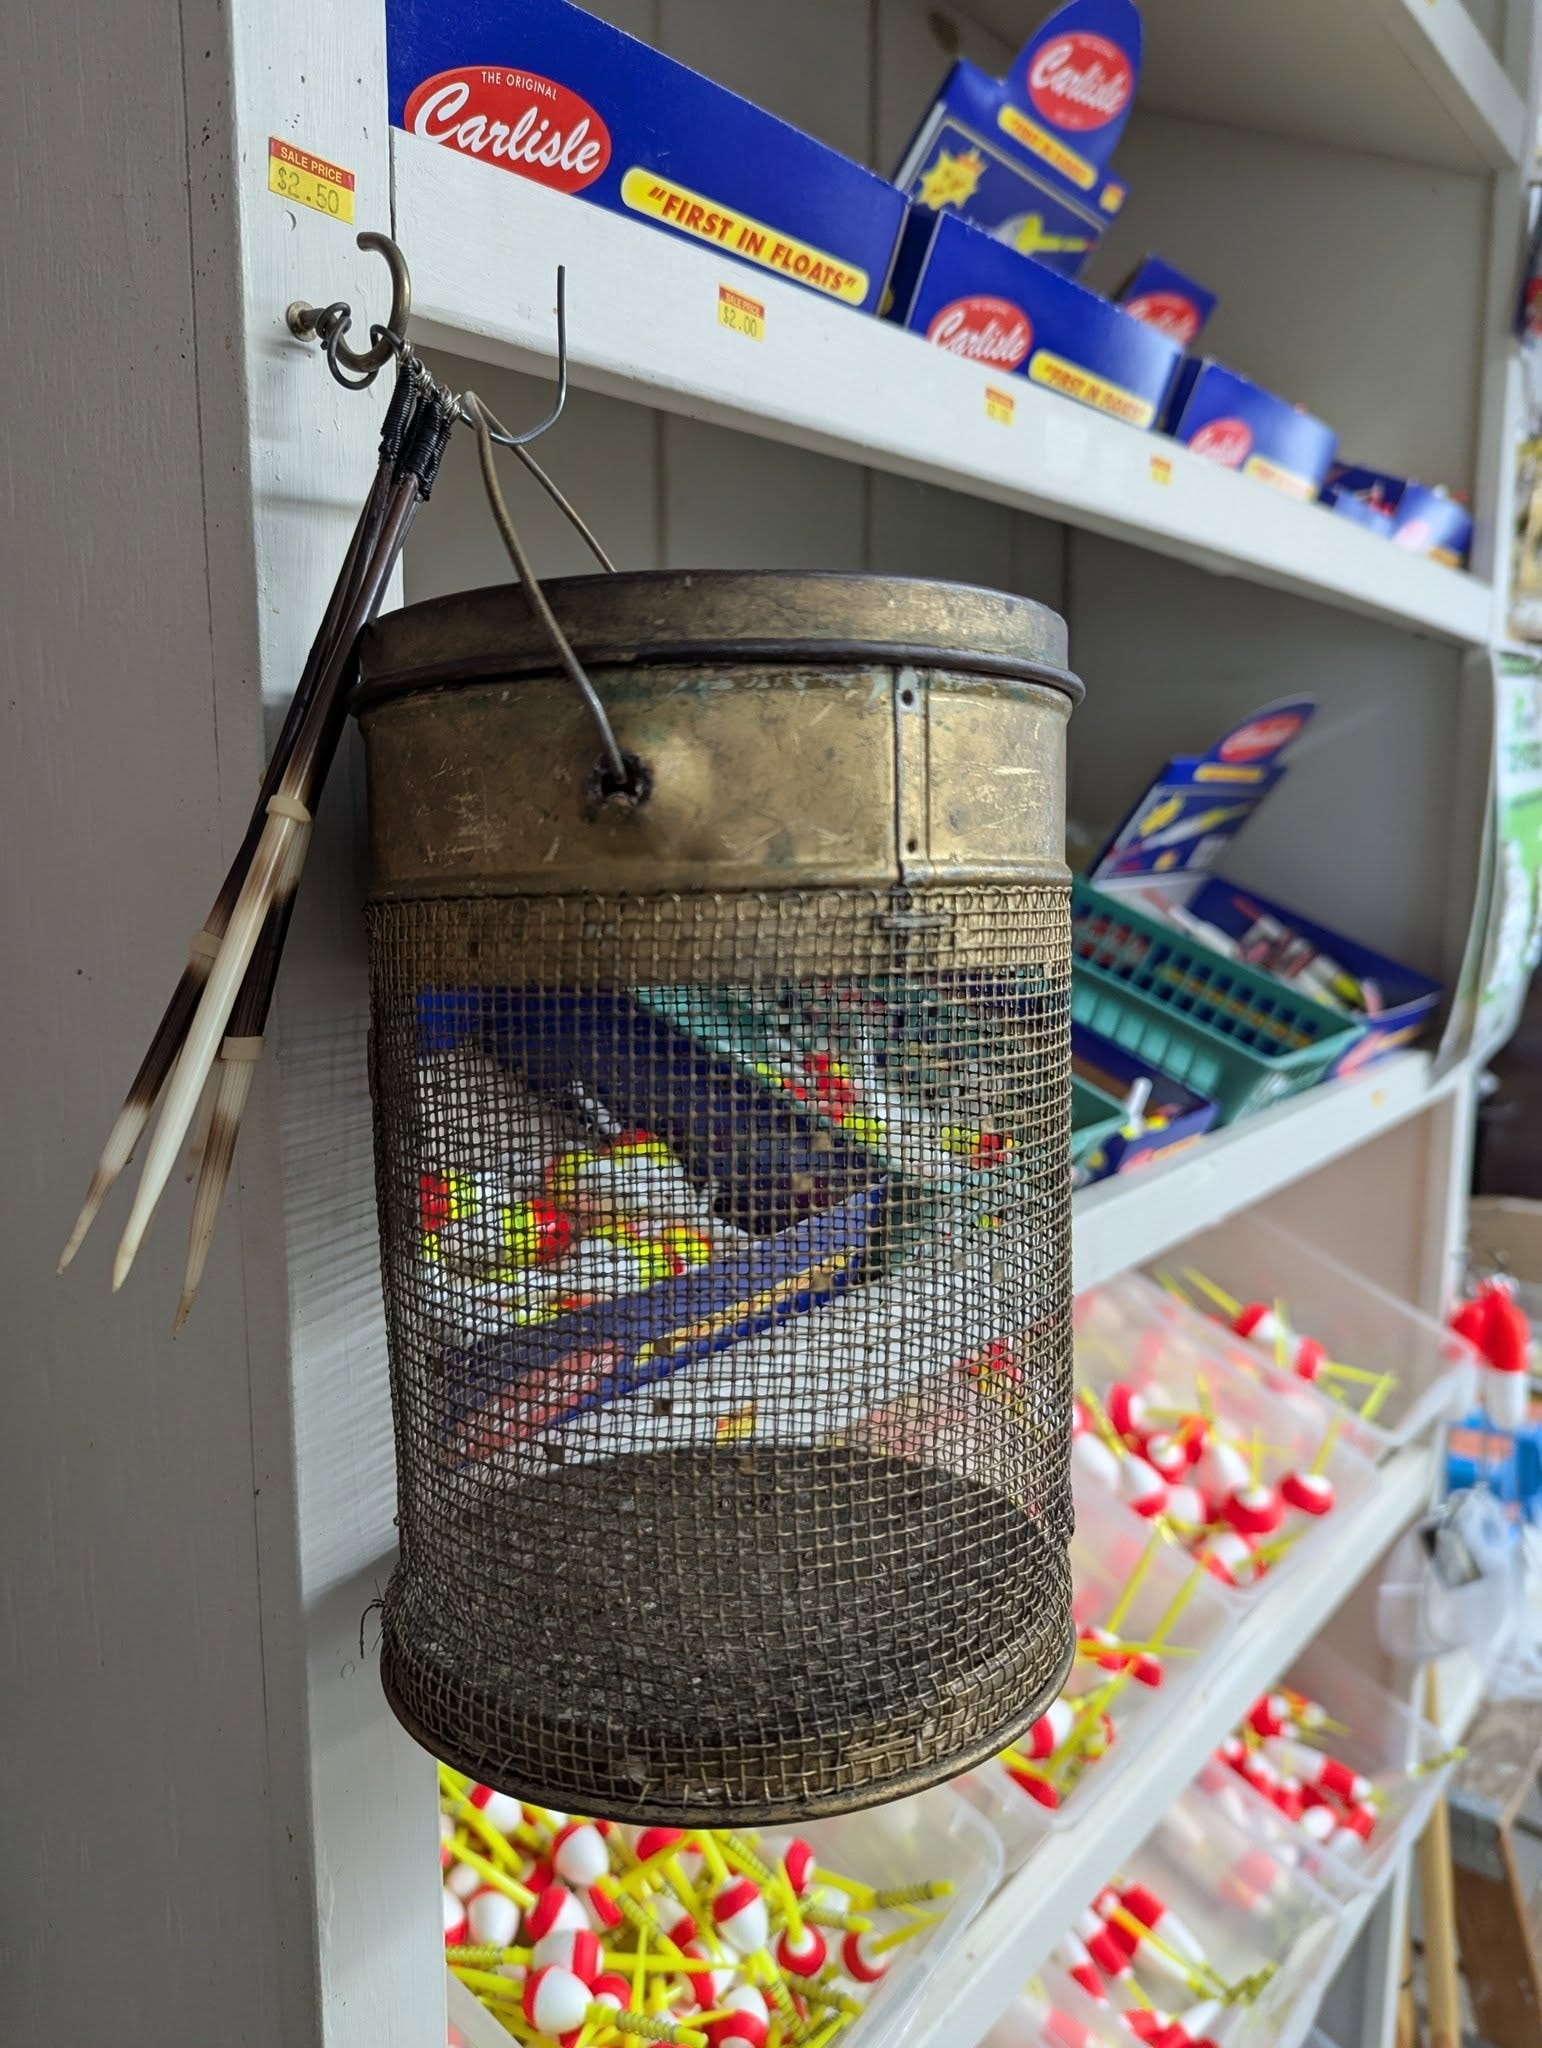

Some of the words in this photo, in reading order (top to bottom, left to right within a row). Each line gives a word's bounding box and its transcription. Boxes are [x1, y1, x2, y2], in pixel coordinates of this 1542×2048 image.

[481, 71, 501, 85] THE
[506, 74, 558, 101] ORIGINAL
[414, 82, 601, 175] Carlisle
[280, 146, 309, 169] SALE
[311, 160, 343, 184] PRICE
[277, 166, 340, 214] $2.50
[648, 186, 734, 241] "FIRST
[736, 227, 767, 257] IN
[769, 243, 857, 292] FLOATS"
[723, 305, 758, 338] $2.00
